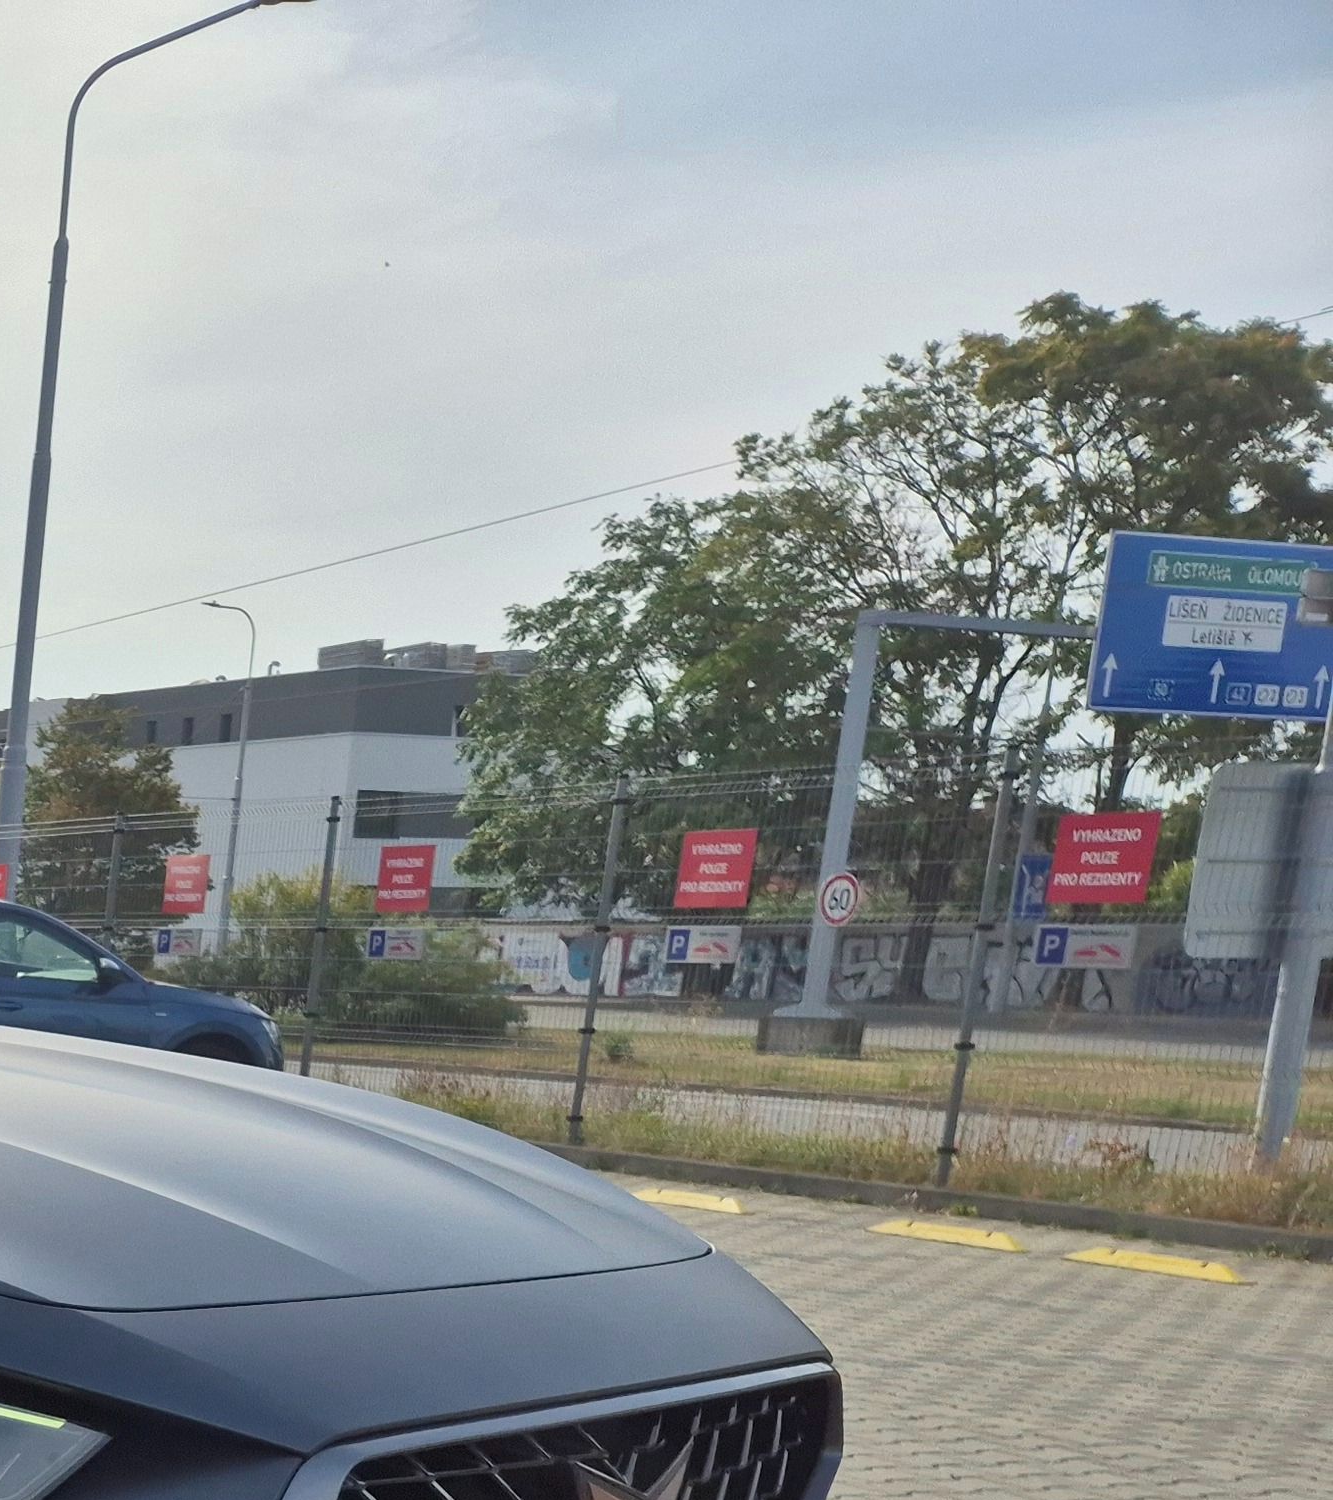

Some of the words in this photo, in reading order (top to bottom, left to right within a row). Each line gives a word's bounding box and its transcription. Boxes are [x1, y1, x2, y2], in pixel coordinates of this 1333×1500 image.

[1173, 561, 1232, 582] OSTRAVA
[1223, 602, 1283, 625] ŽIDENICE
[1073, 828, 1142, 842] VYHRAZENO
[1081, 851, 1120, 865] POUZE
[1053, 873, 1078, 886] PRO
[1079, 872, 1142, 886] REZIDENTY
[671, 935, 685, 955] P
[1044, 935, 1060, 957] P
